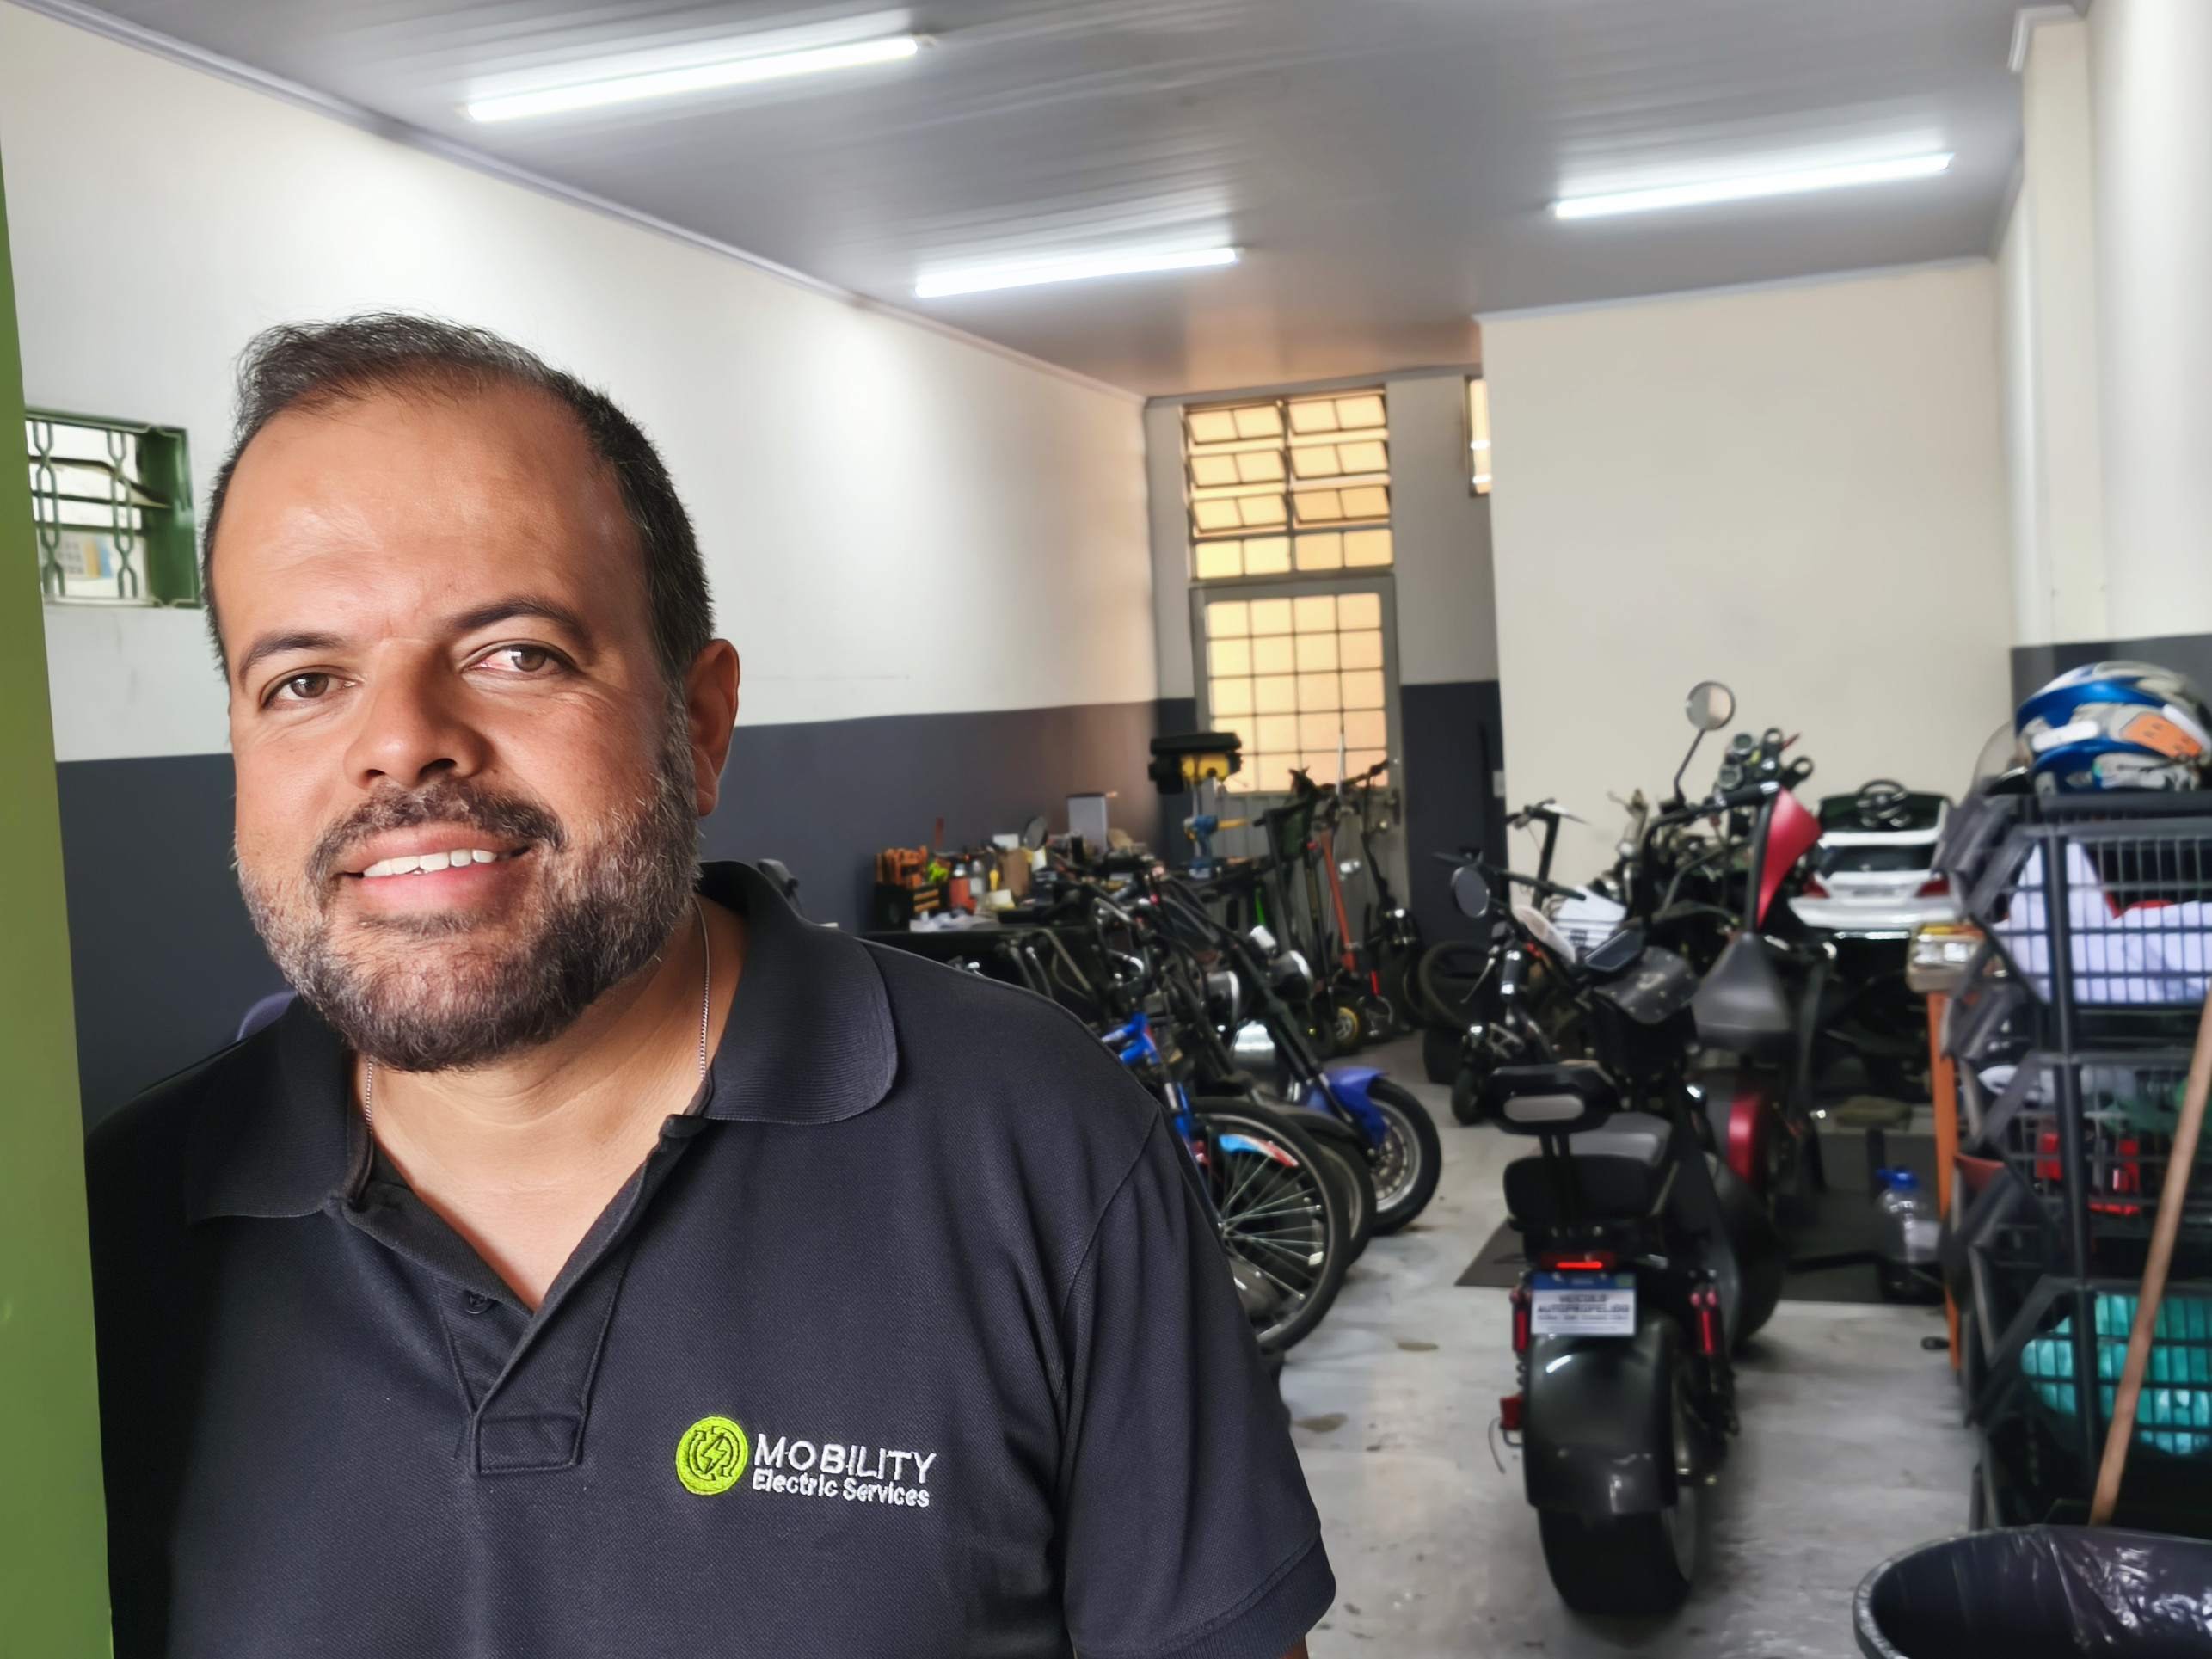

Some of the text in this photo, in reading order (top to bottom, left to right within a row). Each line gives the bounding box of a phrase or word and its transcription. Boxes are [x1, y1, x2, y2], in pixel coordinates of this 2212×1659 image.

[753, 1433, 937, 1484] MOBILITY
[752, 1467, 931, 1508] Electric Services
